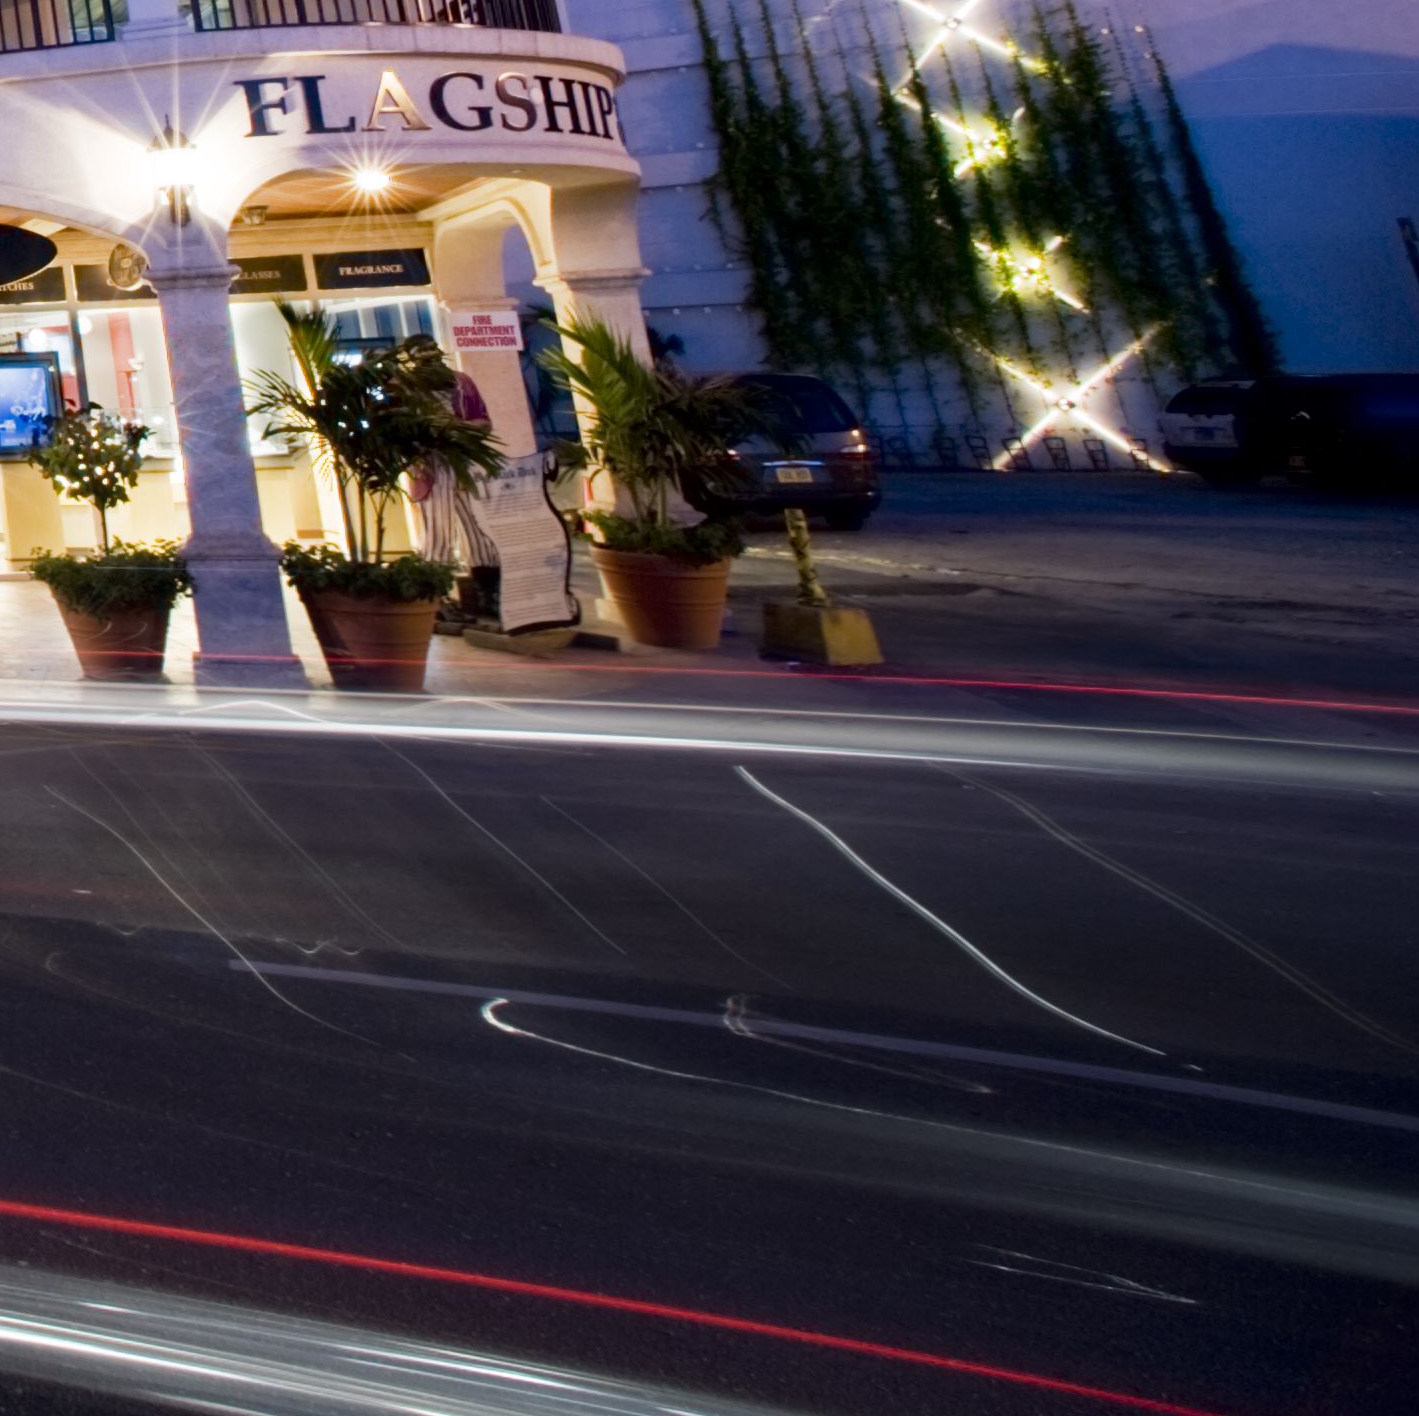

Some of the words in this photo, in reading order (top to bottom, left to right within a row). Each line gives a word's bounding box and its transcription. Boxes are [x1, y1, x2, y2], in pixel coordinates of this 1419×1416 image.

[232, 68, 614, 141] FLAGSHIP
[338, 263, 404, 276] FRAGRANCE
[472, 314, 492, 325] FIRE
[452, 326, 515, 337] DEPARTMENT
[456, 336, 518, 347] CONNECTION
